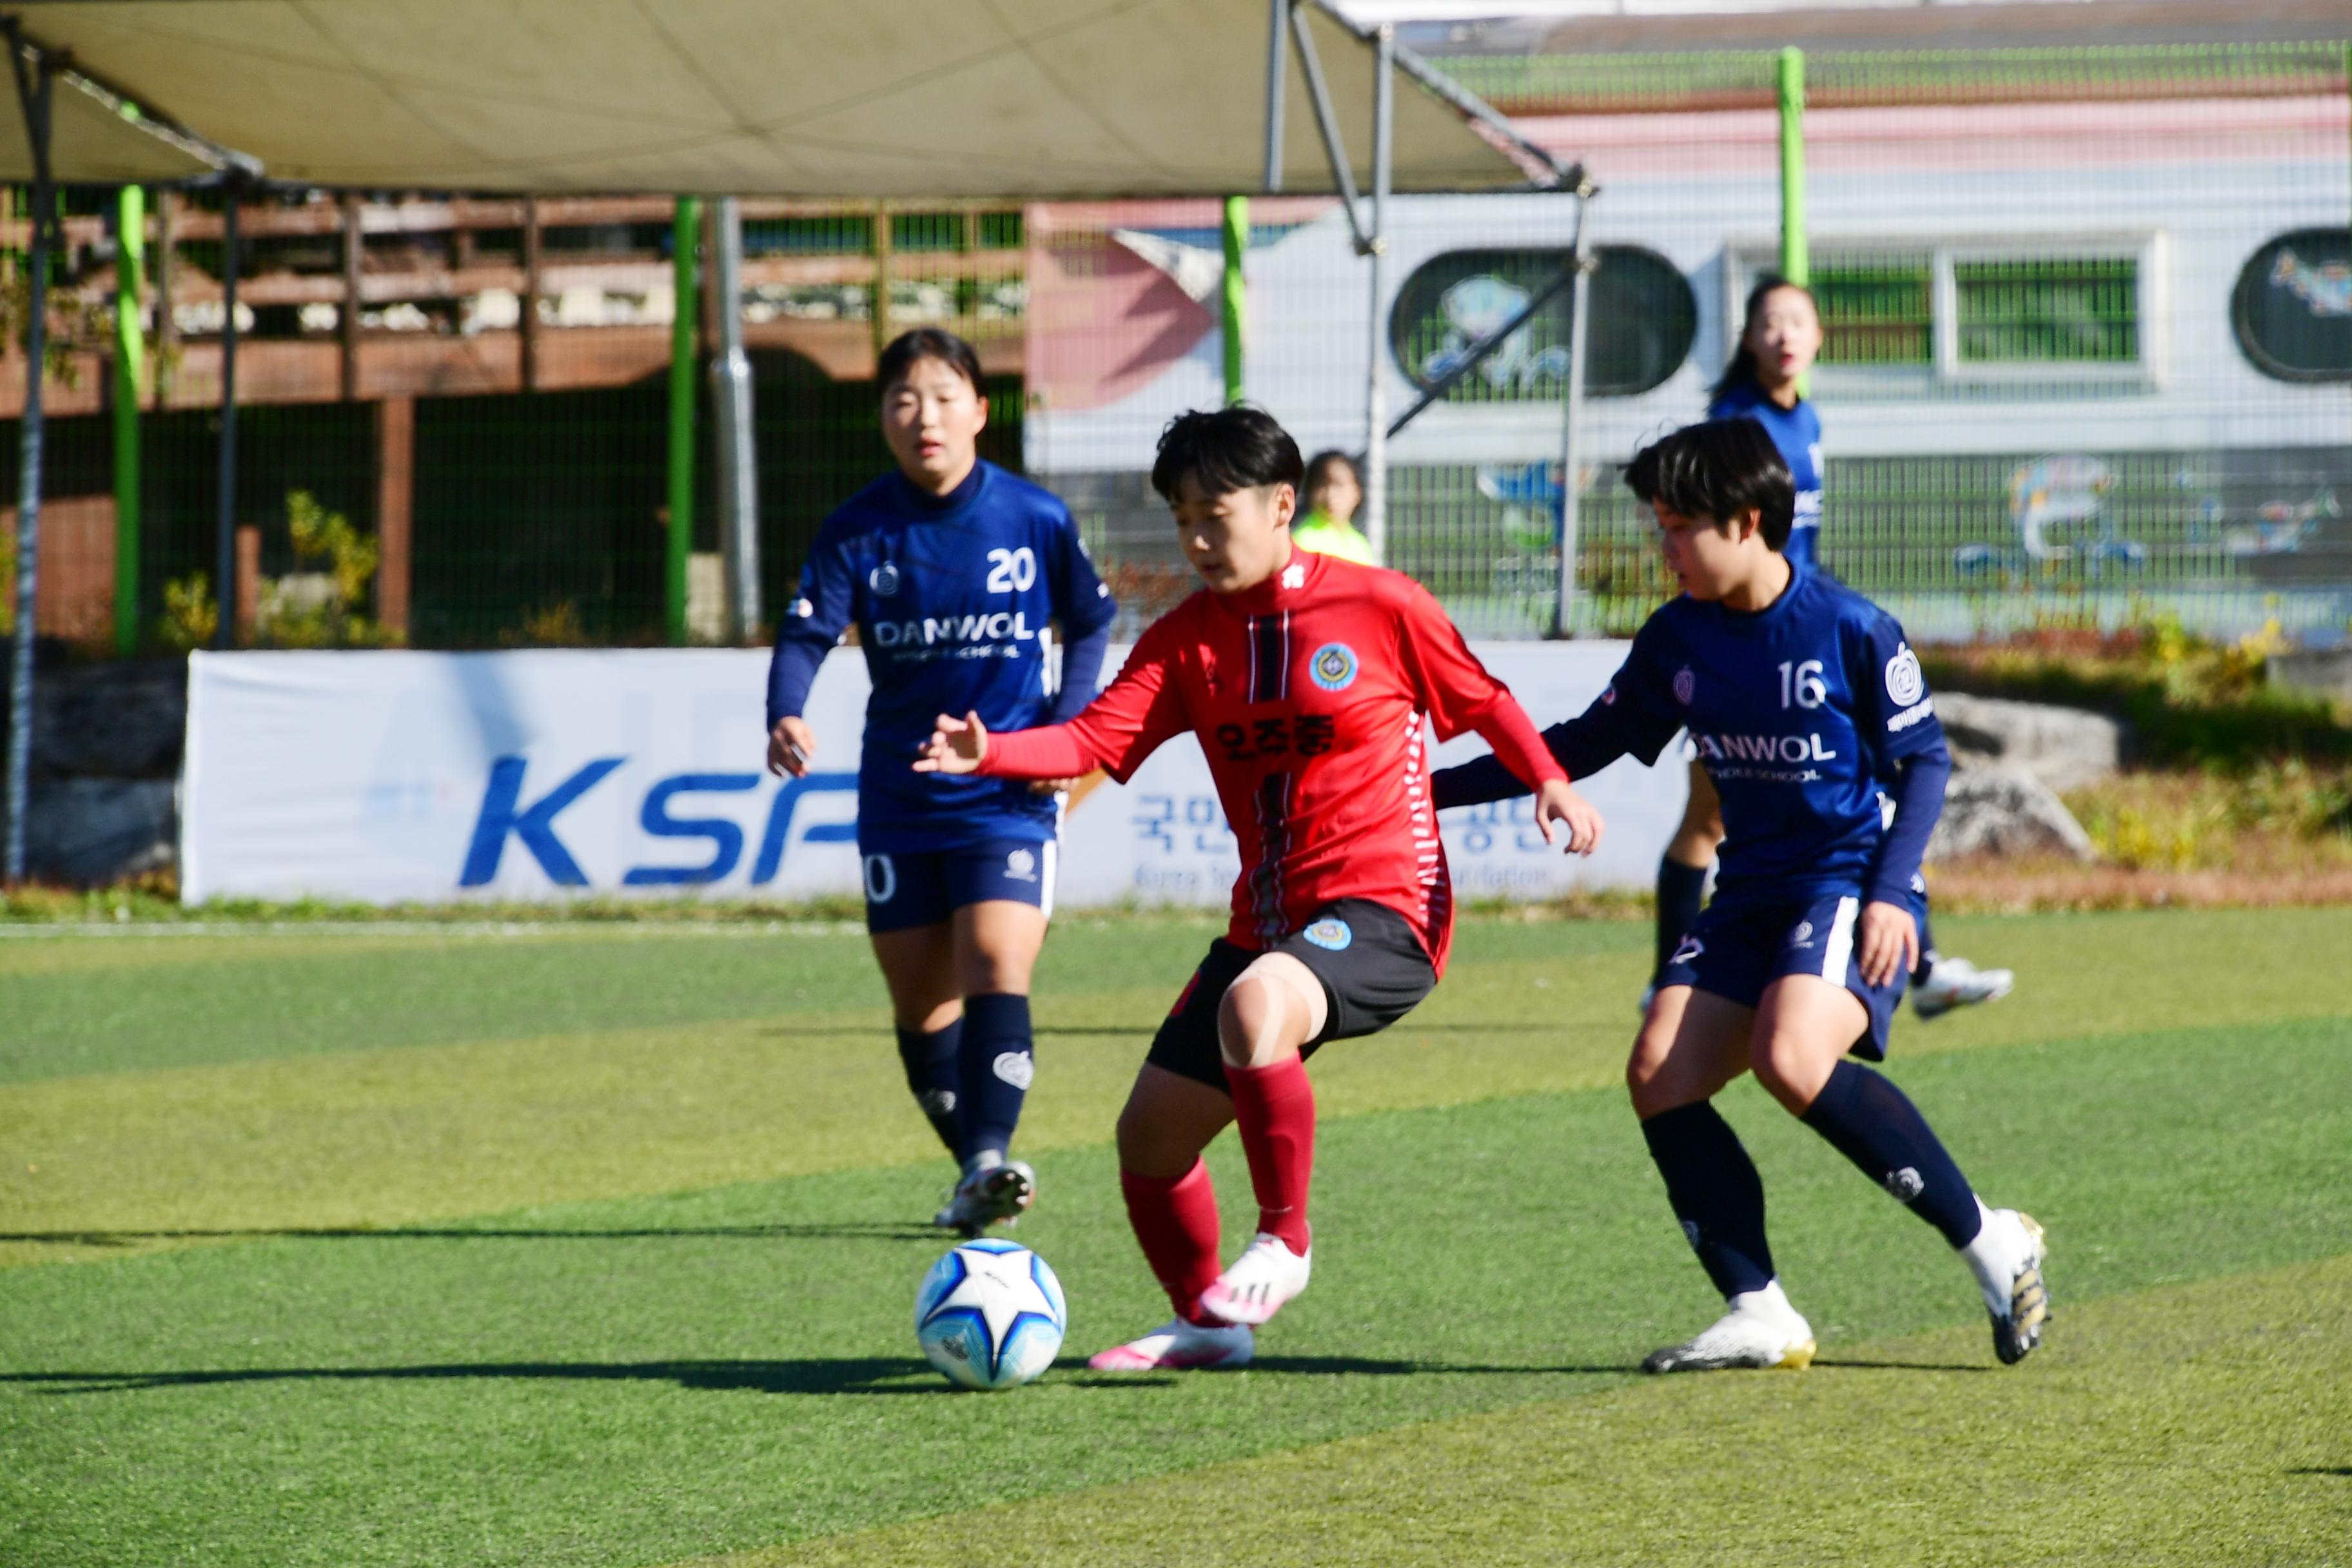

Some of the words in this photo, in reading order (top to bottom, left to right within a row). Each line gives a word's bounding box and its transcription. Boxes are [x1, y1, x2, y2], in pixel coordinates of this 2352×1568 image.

[986, 547, 1037, 594] 20
[873, 611, 1035, 648] DANWOL
[1777, 659, 1827, 710] 16
